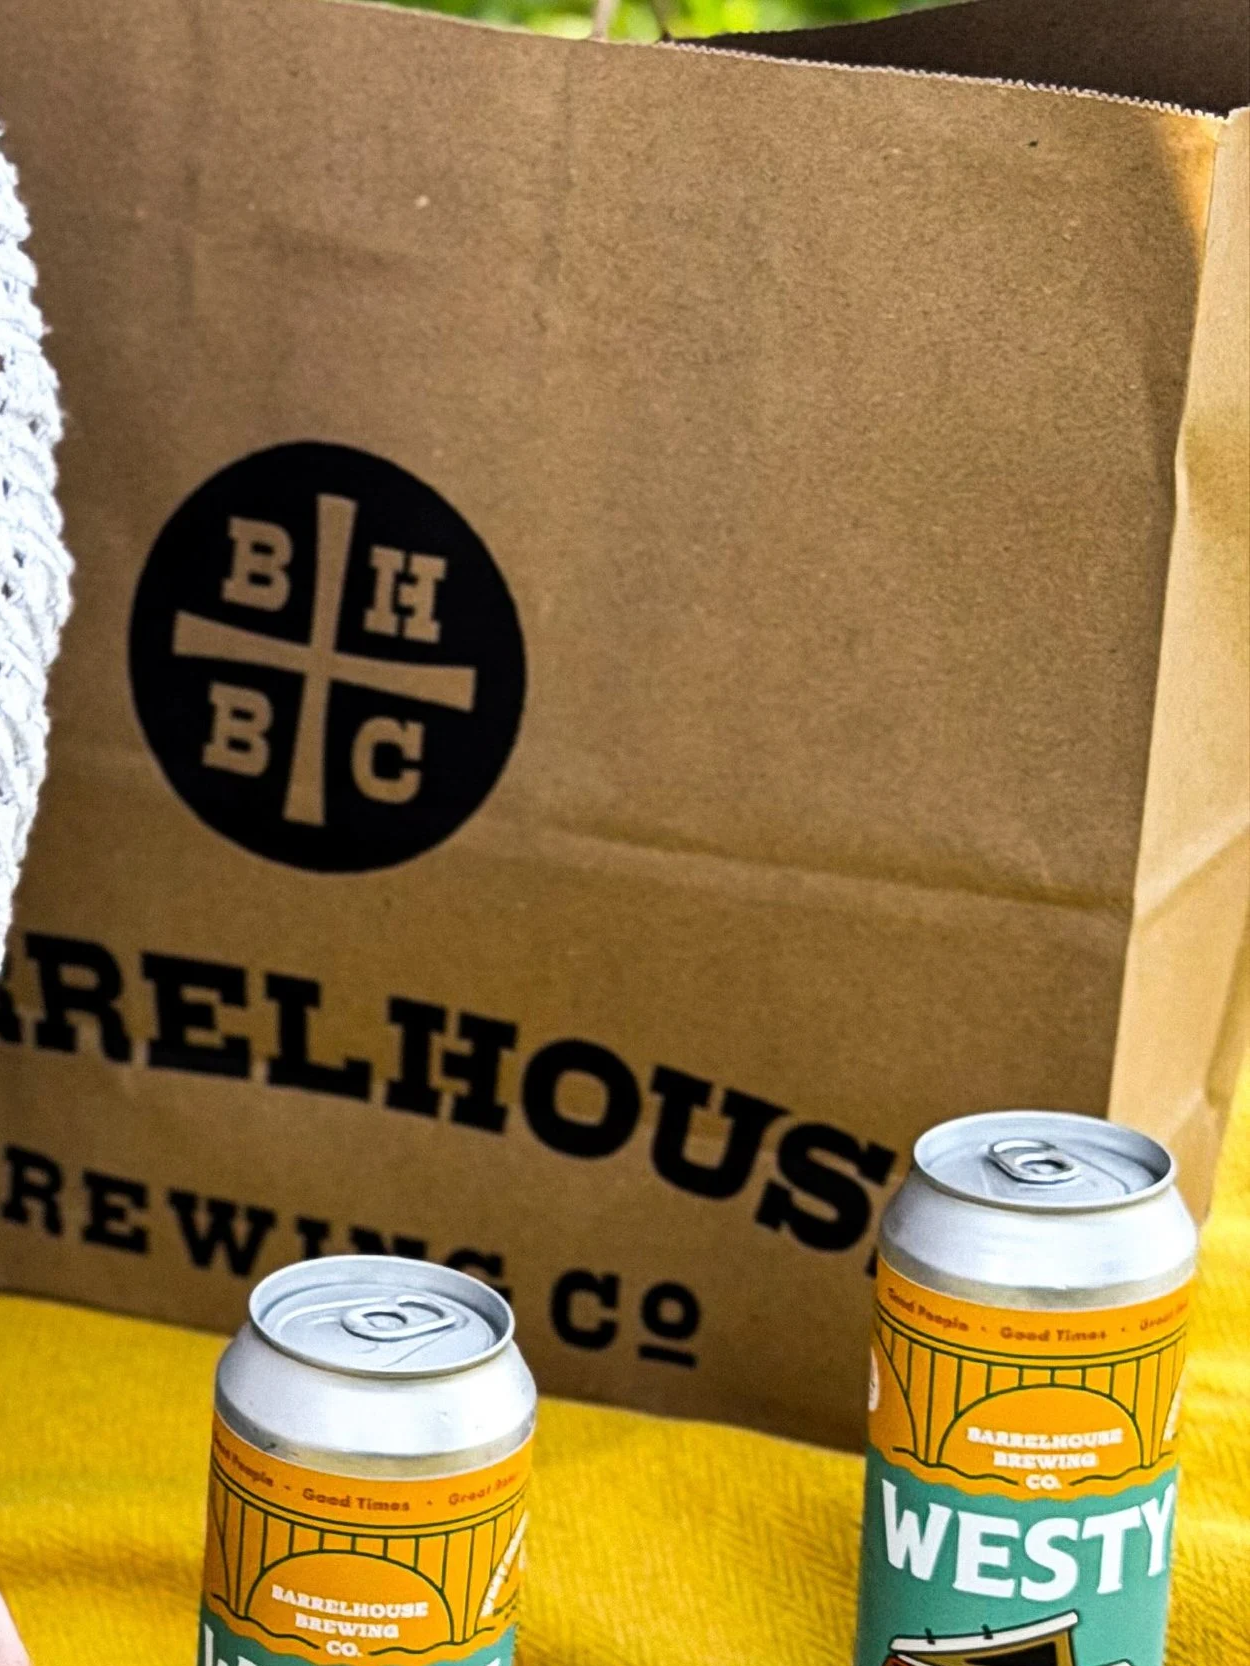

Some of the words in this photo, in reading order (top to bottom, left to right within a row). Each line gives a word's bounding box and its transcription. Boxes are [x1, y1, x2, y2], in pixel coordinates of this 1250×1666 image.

[222, 517, 291, 610] B
[363, 546, 448, 644] H
[202, 682, 272, 777] B
[352, 717, 424, 804] C
[1001, 1326, 1049, 1341] Good
[1056, 1328, 1107, 1341] Times
[967, 1427, 1123, 1450] BARRELHOUSE
[993, 1452, 1098, 1470] BREWING
[302, 1487, 350, 1508] Good
[356, 1498, 410, 1511] Times
[881, 1478, 1175, 1602] WESTY
[271, 1584, 429, 1619] BARRELHOUSE
[295, 1612, 399, 1639] BREWING
